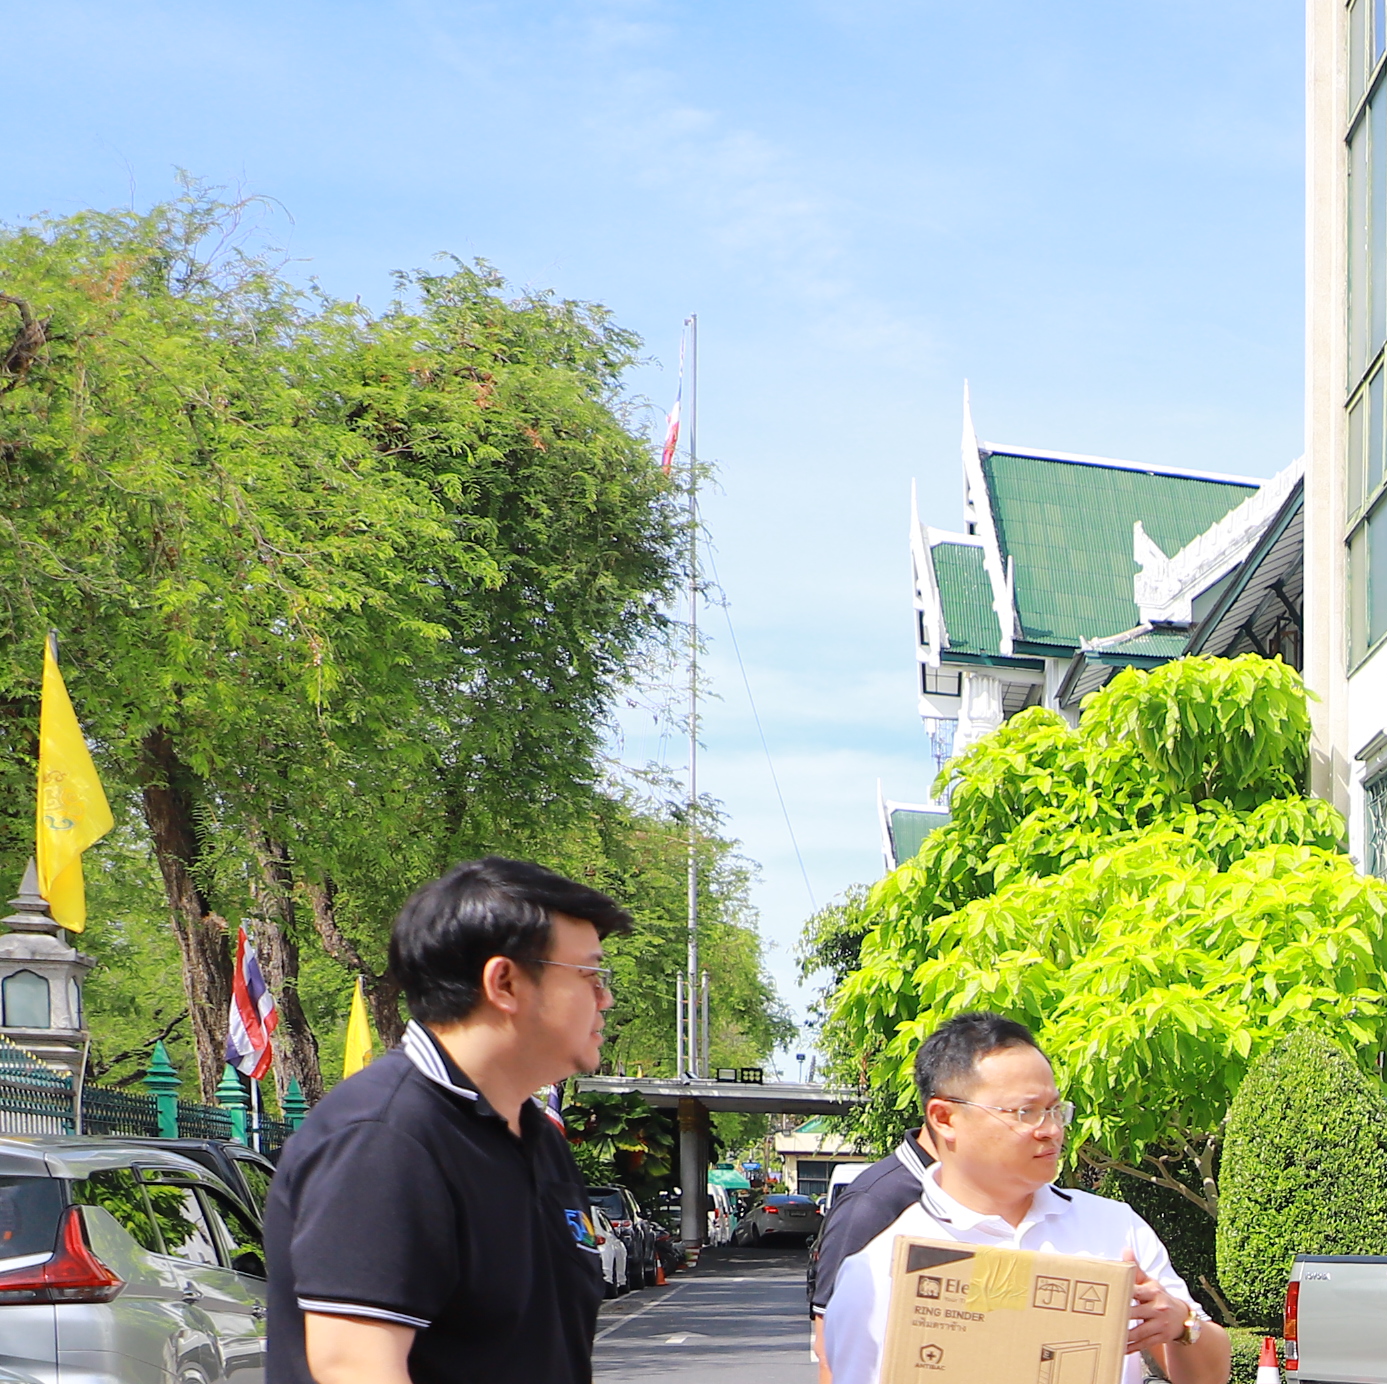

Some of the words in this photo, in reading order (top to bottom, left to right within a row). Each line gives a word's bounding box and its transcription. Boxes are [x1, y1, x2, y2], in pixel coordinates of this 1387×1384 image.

[945, 1278, 970, 1294] Ele
[914, 1305, 941, 1317] RING
[945, 1309, 985, 1322] BINDER
